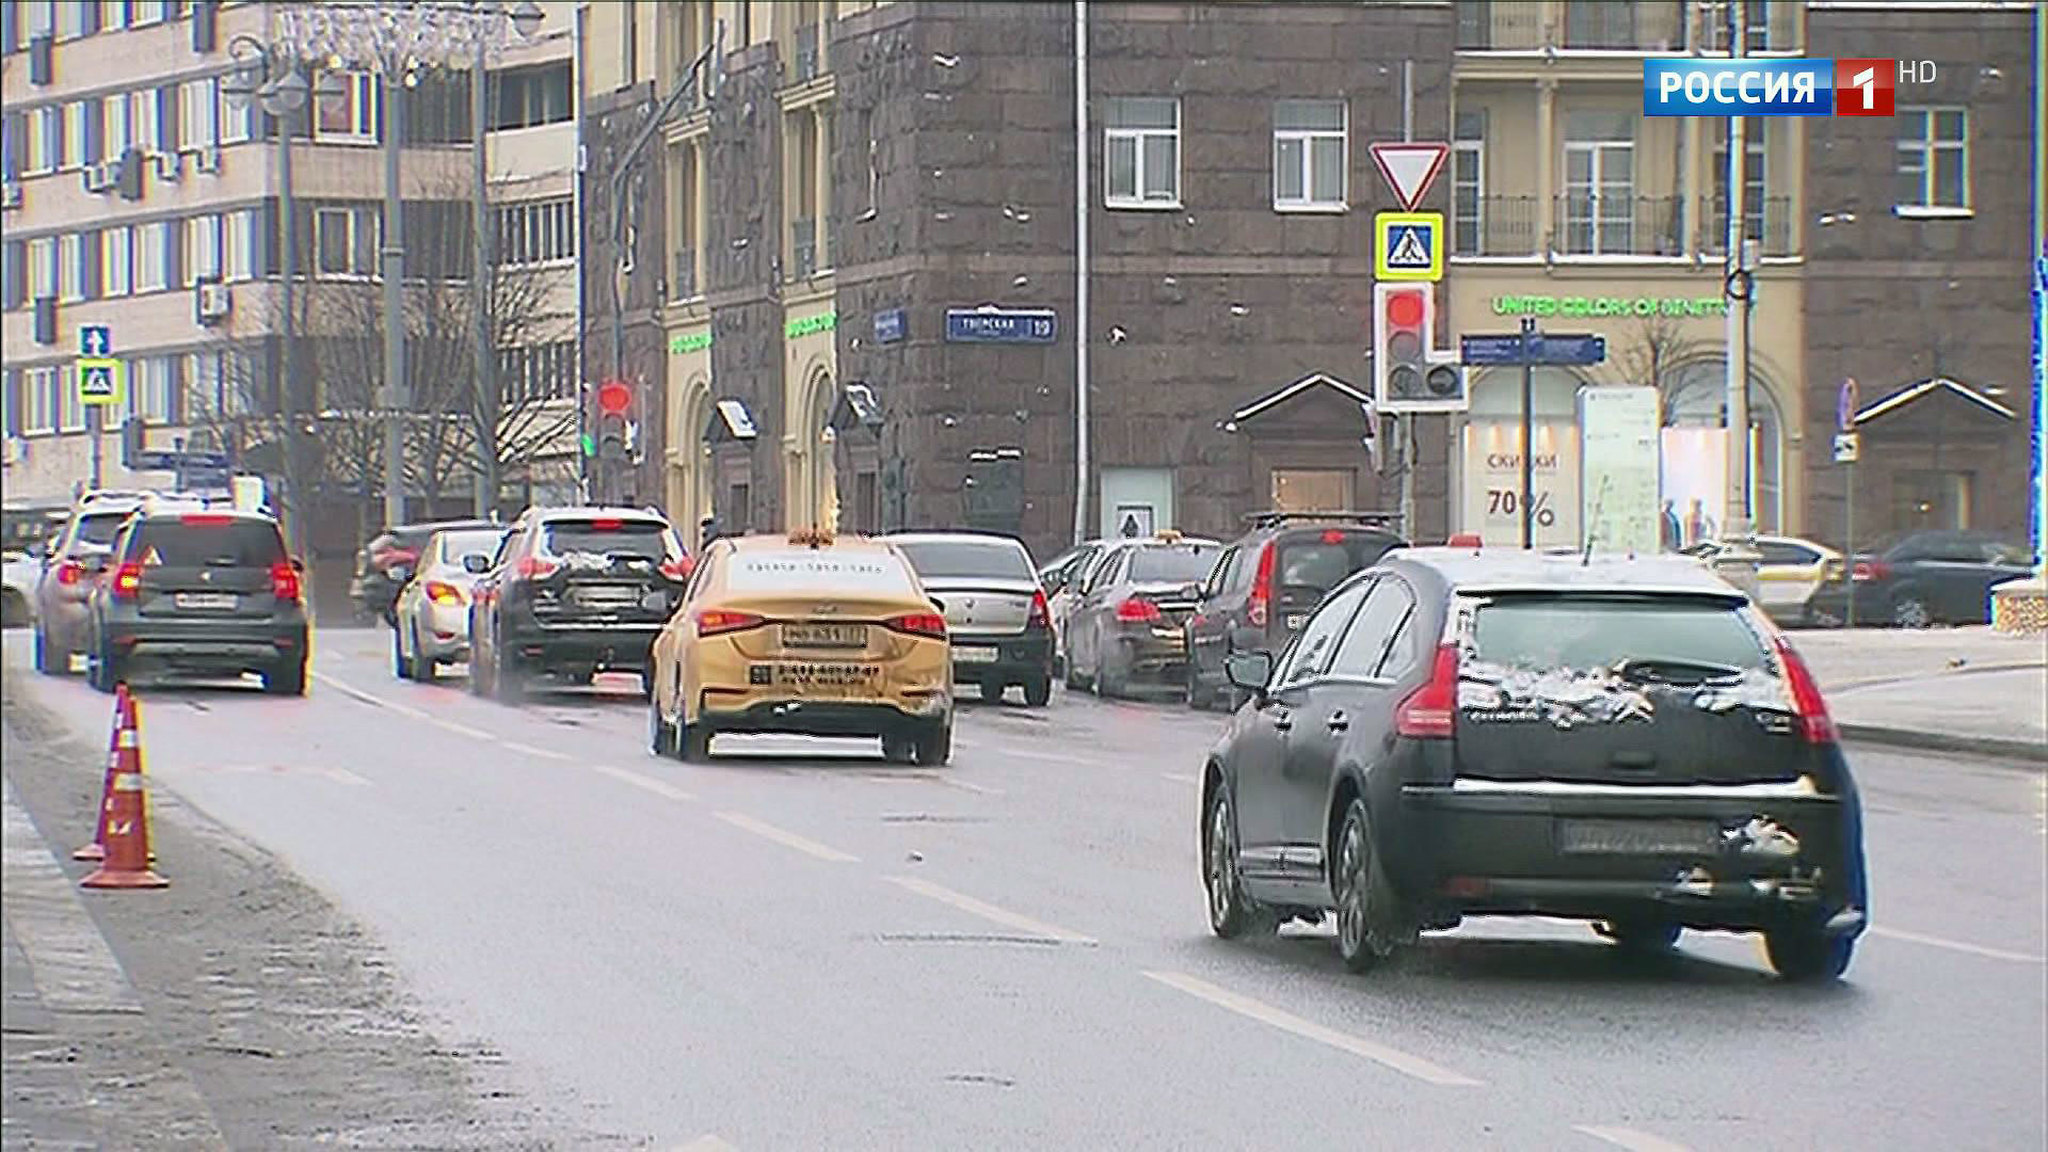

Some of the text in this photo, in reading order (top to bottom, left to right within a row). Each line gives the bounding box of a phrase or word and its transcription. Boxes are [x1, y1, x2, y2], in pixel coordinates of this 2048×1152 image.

[1491, 295, 1556, 316] UNITED
[1559, 297, 1632, 317] COLORS
[1033, 319, 1051, 336] 19
[1487, 453, 1558, 470] СКИКИ
[1487, 490, 1555, 527] 70%
